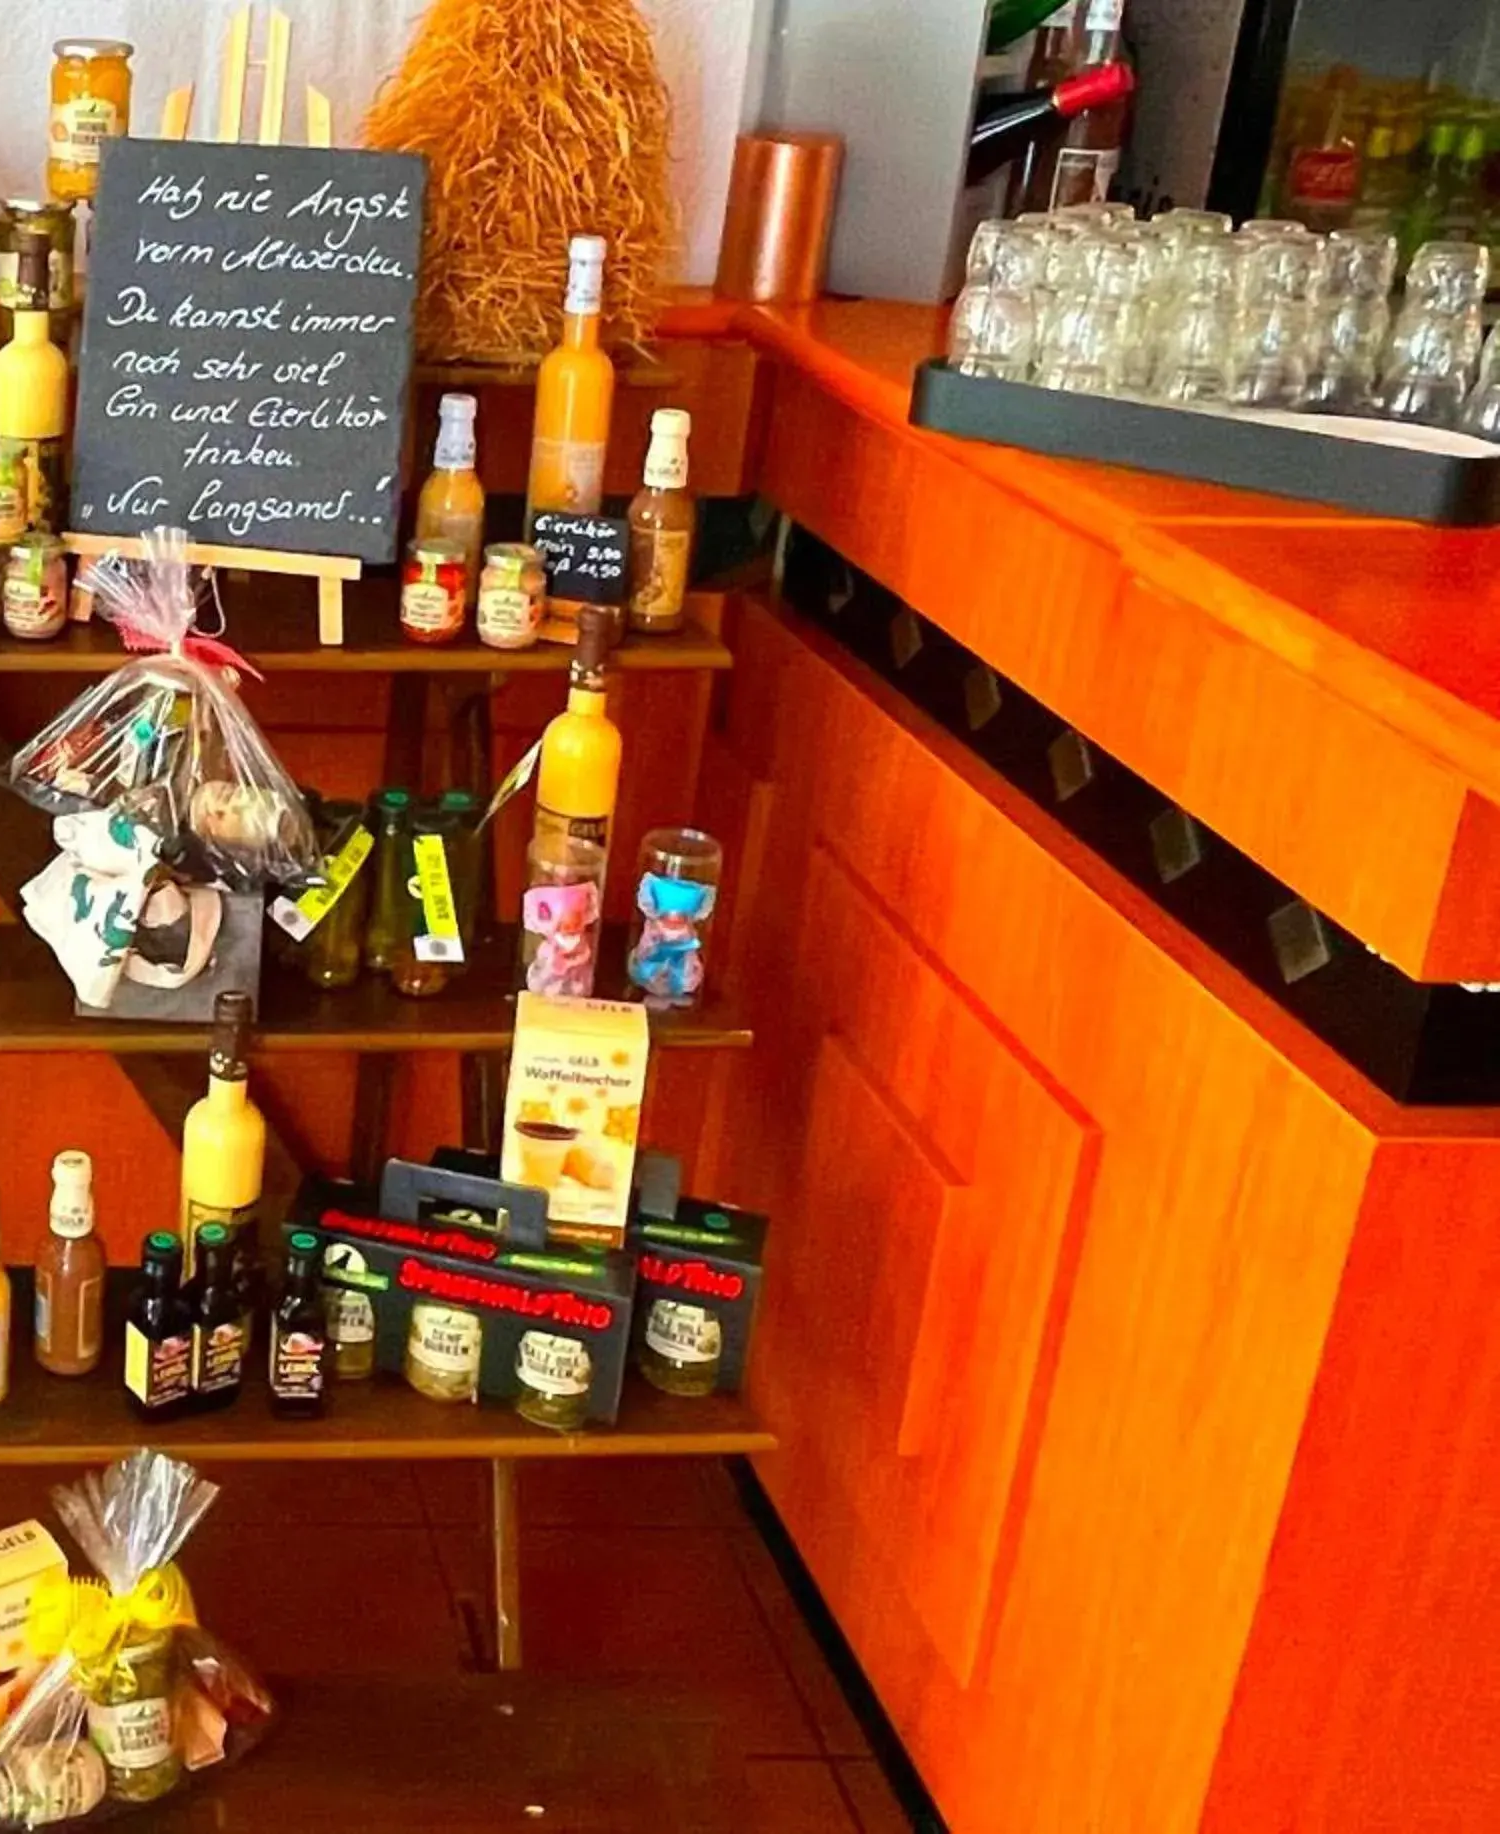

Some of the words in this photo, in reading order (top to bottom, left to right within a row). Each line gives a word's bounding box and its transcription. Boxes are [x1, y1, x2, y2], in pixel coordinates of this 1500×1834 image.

[215, 173, 273, 212] nie
[287, 181, 411, 250] Angst
[134, 238, 214, 266] vorm
[221, 236, 416, 280] Altwerden.
[106, 286, 159, 327] Du
[168, 294, 281, 331] kannst
[289, 304, 396, 334] immer
[112, 347, 181, 376] noch
[193, 350, 264, 382] sehr
[273, 351, 346, 388] viel
[105, 384, 159, 419] Gin
[170, 398, 239, 424] und
[248, 394, 388, 430] Eierlikör
[525, 1064, 632, 1088] Waffelbecher
